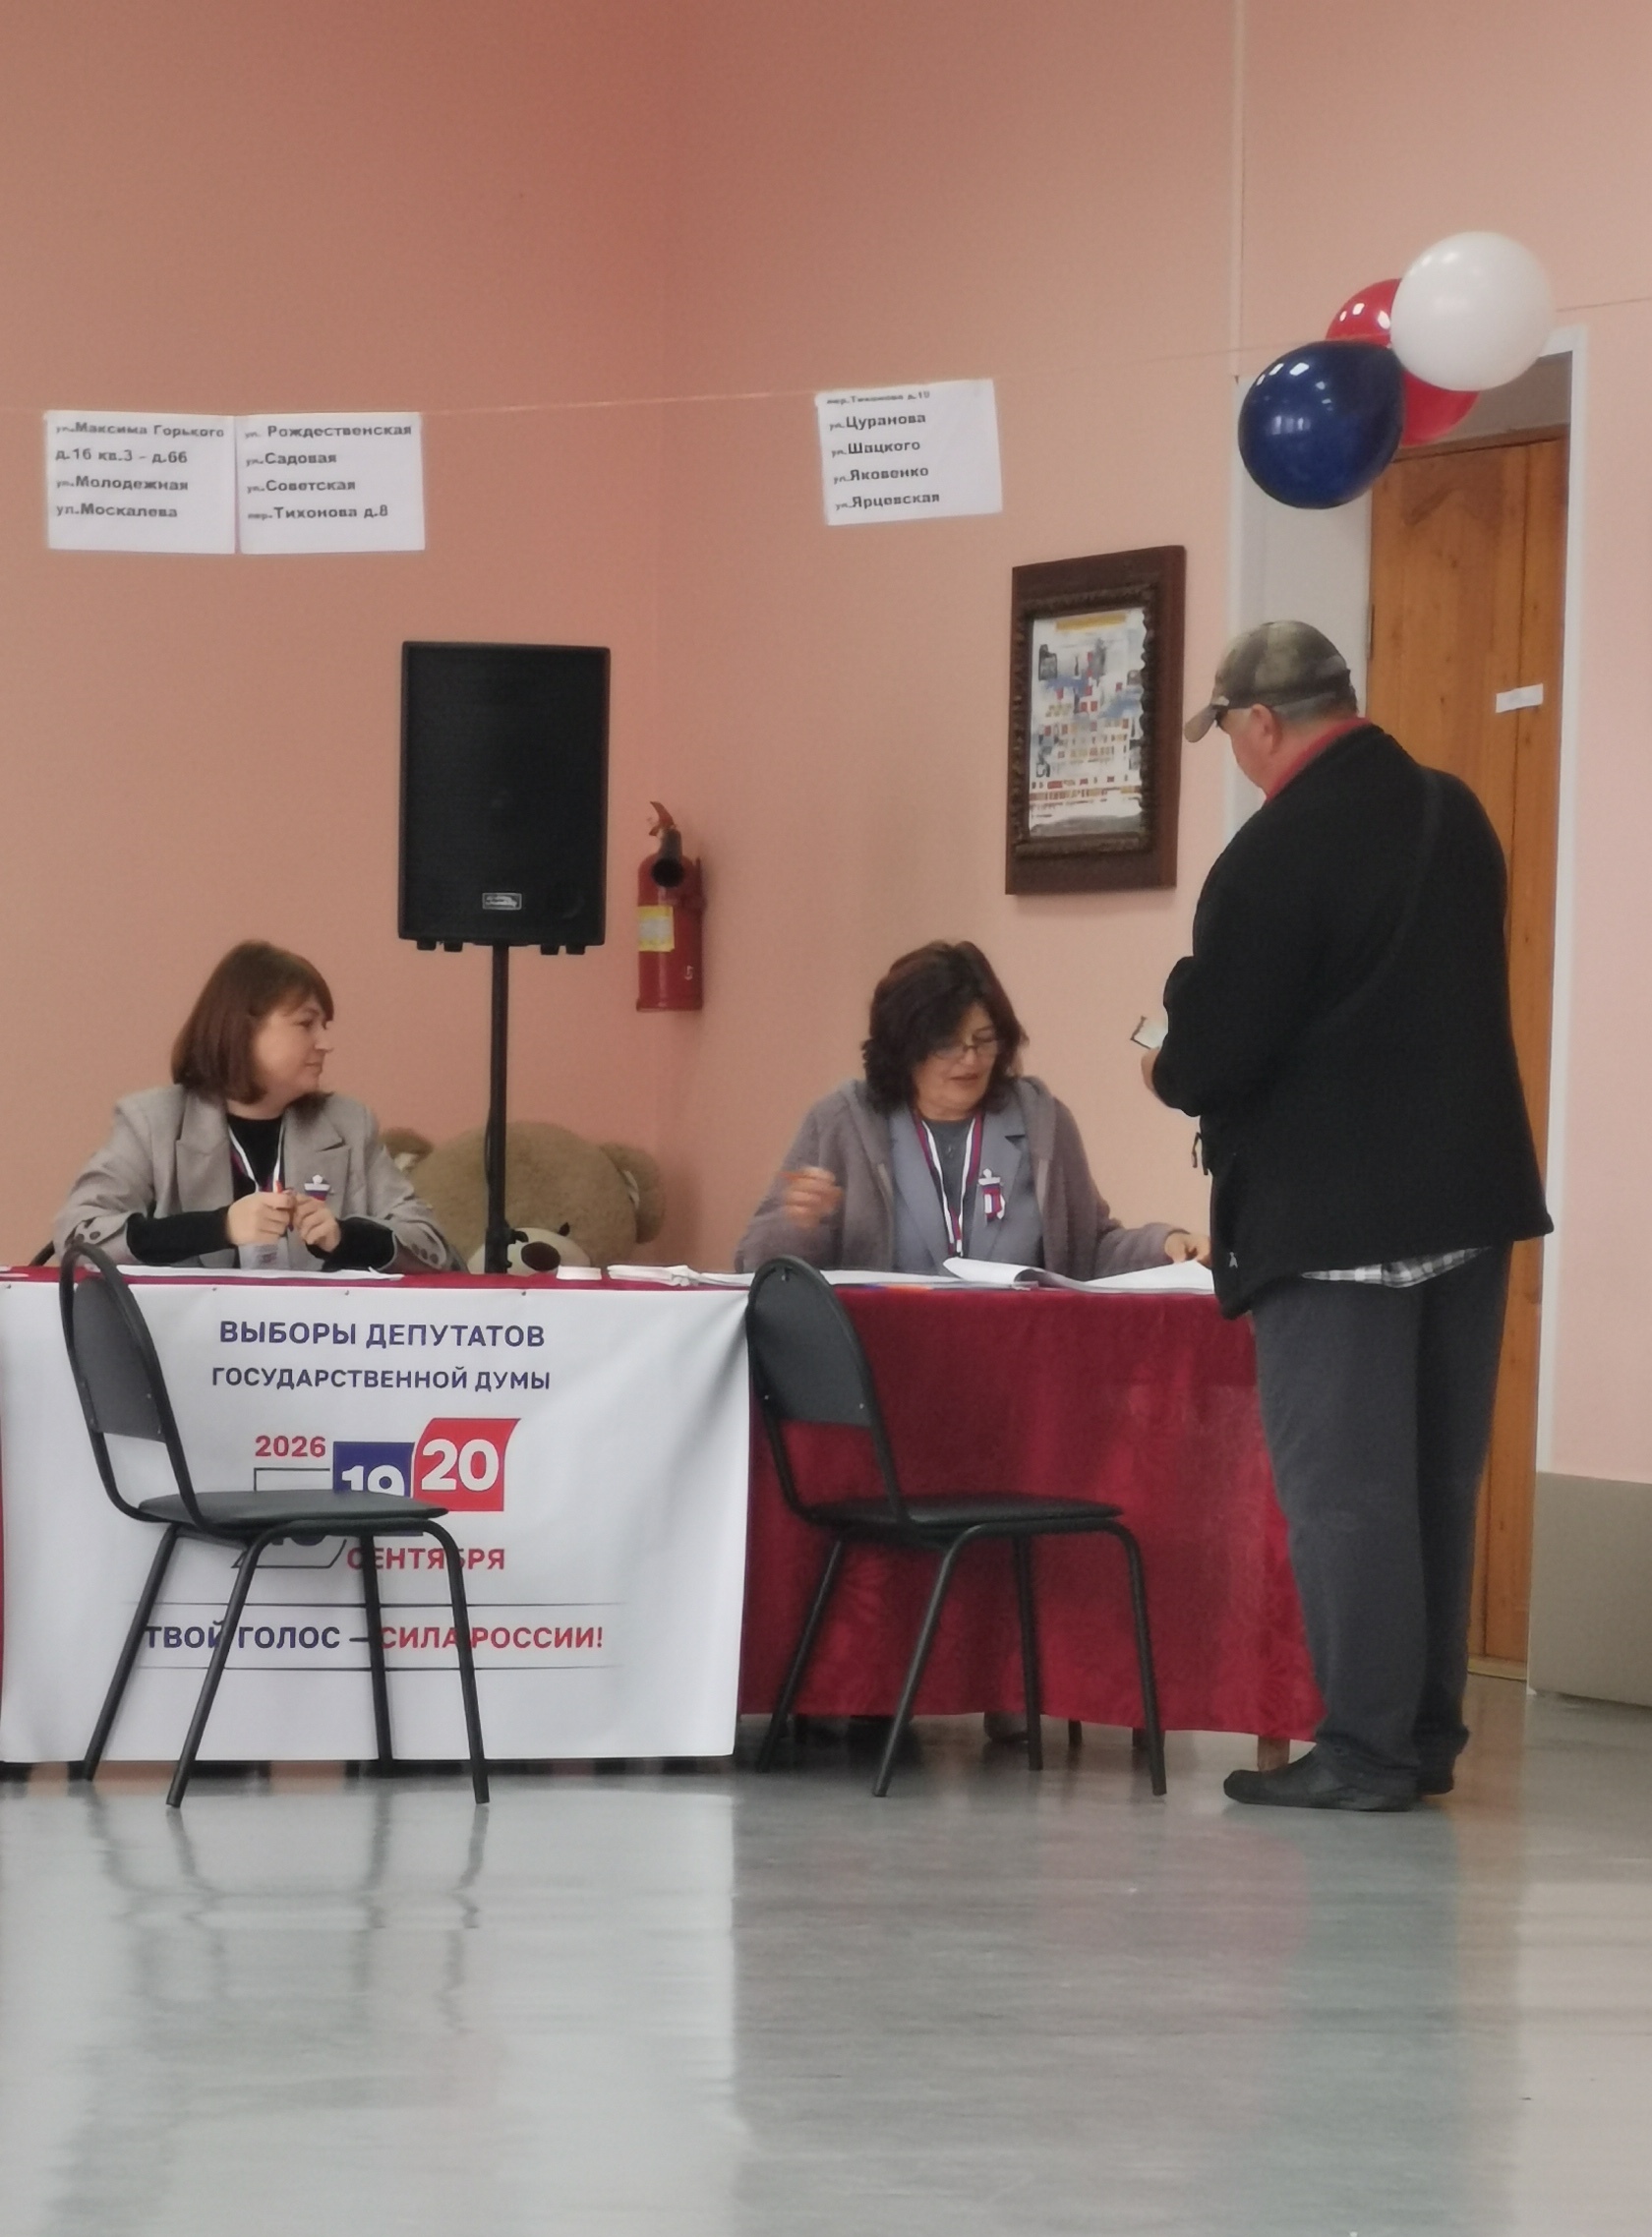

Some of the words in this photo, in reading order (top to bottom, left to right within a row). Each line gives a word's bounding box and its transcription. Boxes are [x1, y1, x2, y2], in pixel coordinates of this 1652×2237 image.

[153, 424, 225, 439] Горького
[267, 425, 412, 439] Рождественская
[55, 448, 92, 461] д.16
[98, 449, 134, 462] кв.3
[151, 451, 189, 464] д.66
[56, 502, 178, 518] ул.Москалева
[363, 504, 389, 519] д.8
[220, 1321, 356, 1345] ВЫБОРЫ
[366, 1324, 546, 1349] ДЕПУТАТОВ
[212, 1366, 468, 1390] ГОСУДАРСТВЕННОЙ
[474, 1372, 551, 1392] ДУМЫ
[255, 1436, 326, 1458] 2026
[421, 1439, 500, 1493] 20
[238, 1625, 340, 1650] ГОЛОС
[381, 1626, 460, 1649] СИЛА
[470, 1626, 603, 1649] РОССИИ!
